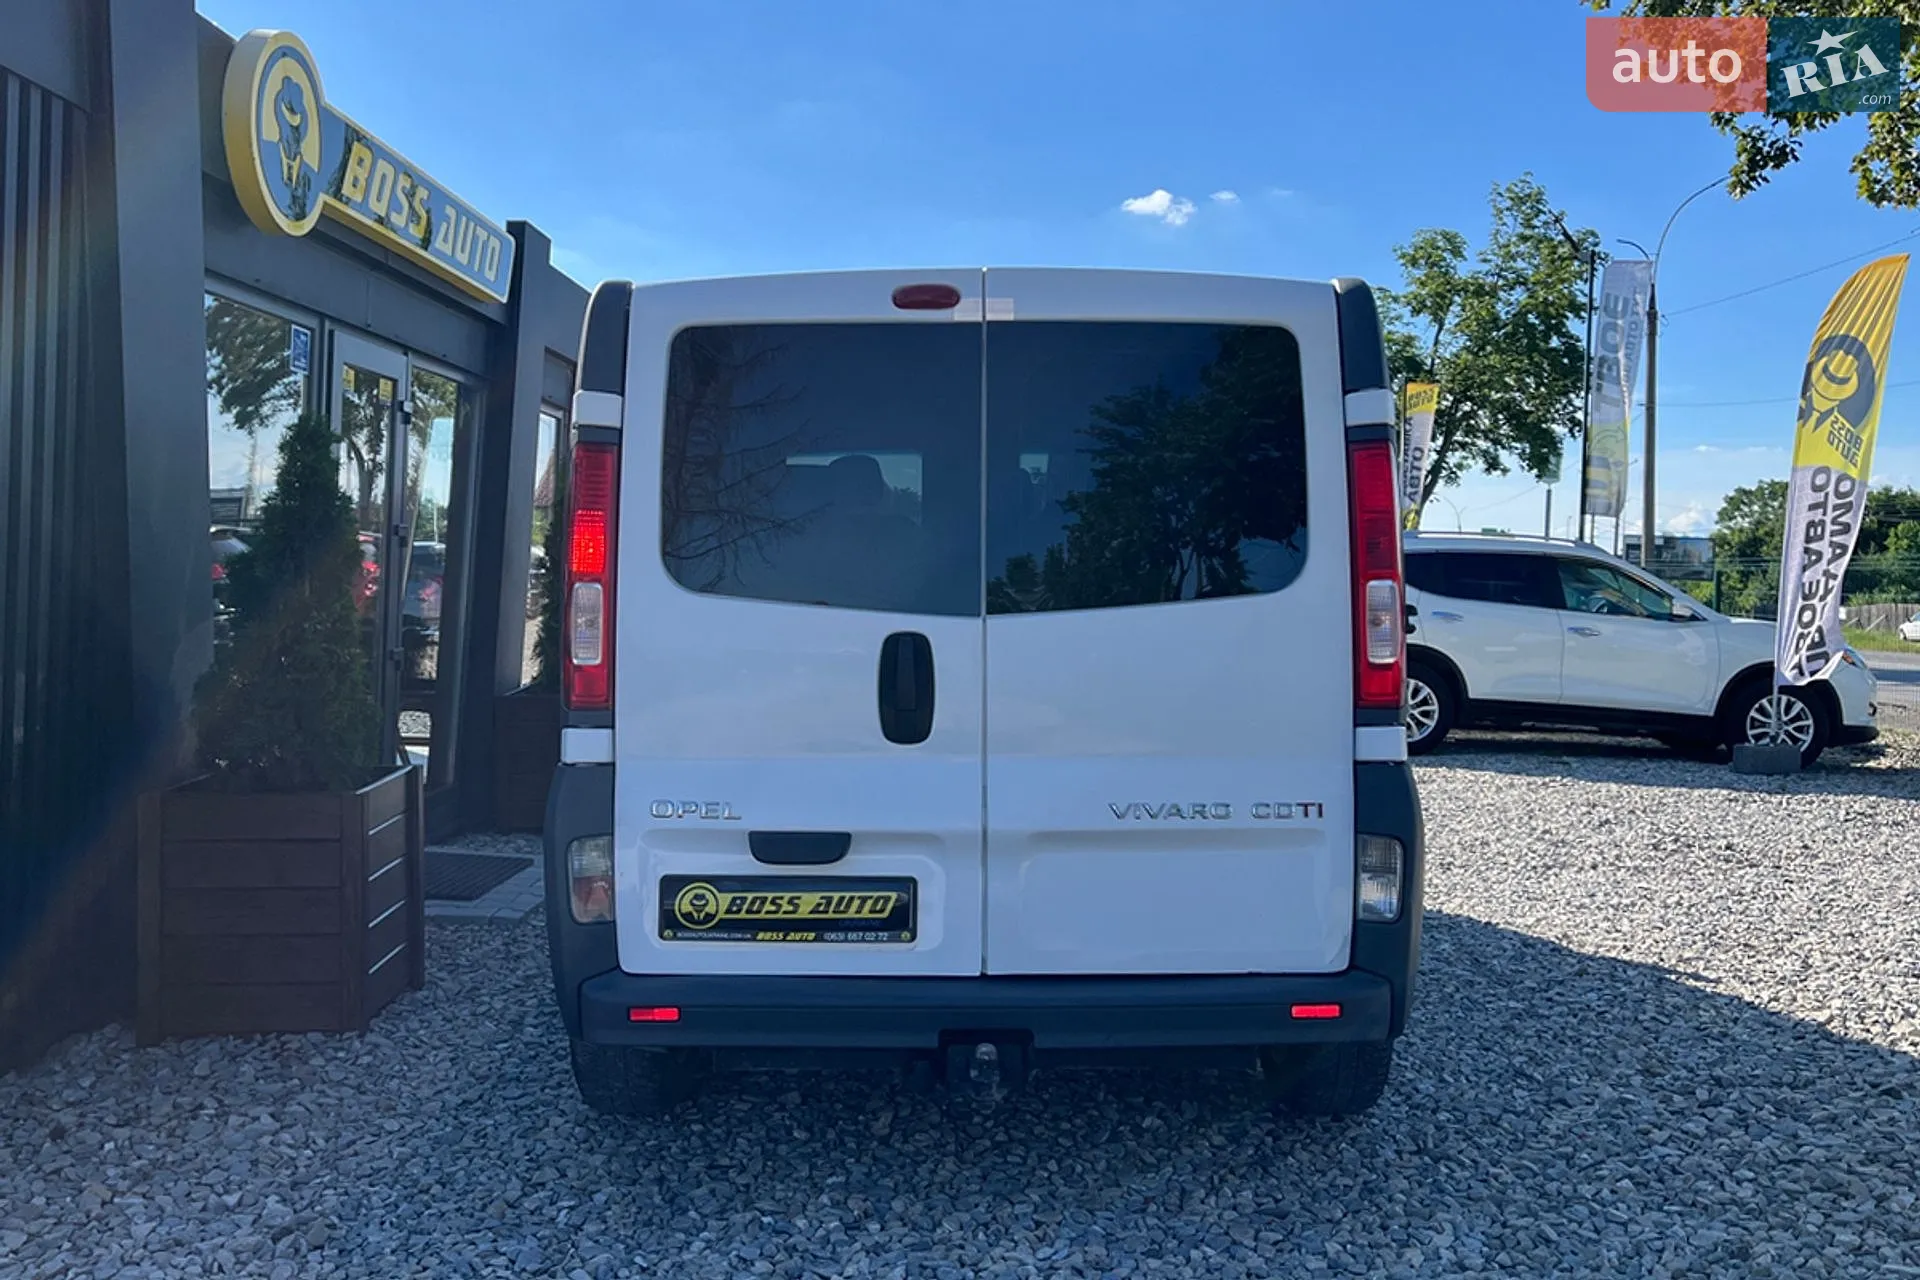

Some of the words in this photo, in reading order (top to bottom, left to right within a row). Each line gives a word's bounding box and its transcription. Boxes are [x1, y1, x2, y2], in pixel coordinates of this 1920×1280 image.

[341, 140, 430, 238] BOSS
[435, 204, 501, 282] AUTO
[1407, 446, 1425, 501] АВТО
[650, 800, 743, 820] OPEL
[1107, 802, 1234, 820] VIVARO
[1251, 802, 1325, 820] CDTI
[723, 895, 803, 915] BOSS
[808, 895, 894, 915] AUTO
[756, 931, 785, 941] BOSS
[785, 931, 817, 941] AUTO
